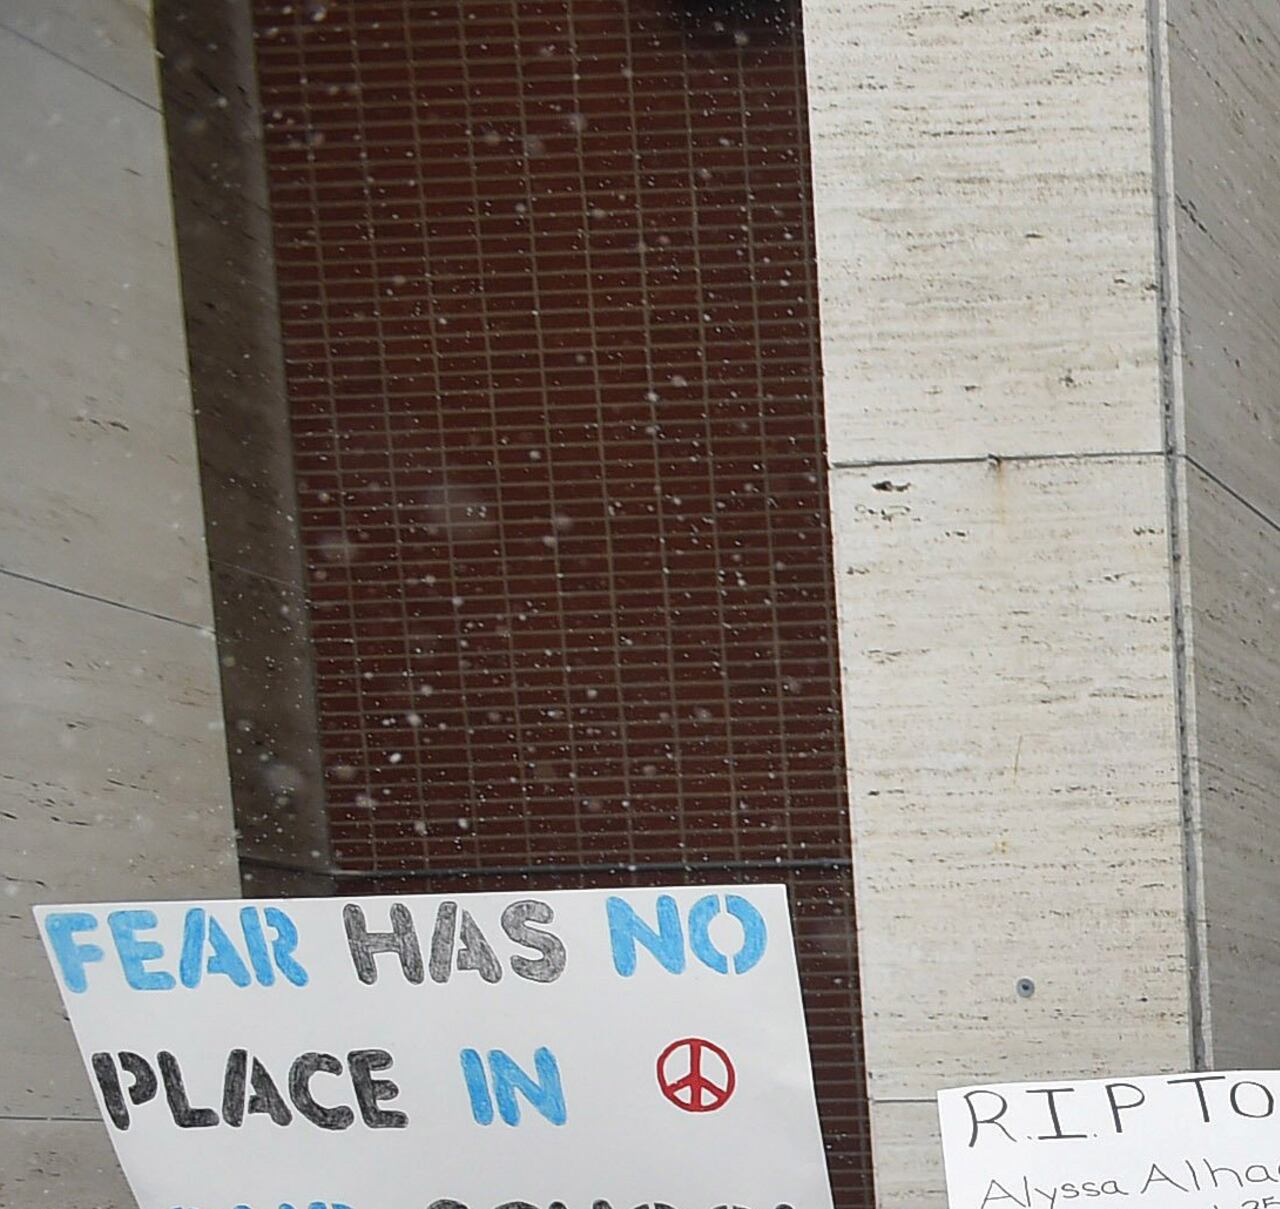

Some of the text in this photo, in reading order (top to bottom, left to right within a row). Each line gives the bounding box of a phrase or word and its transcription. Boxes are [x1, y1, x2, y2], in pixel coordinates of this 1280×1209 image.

[43, 893, 768, 994] FEAR HAS NO
[91, 1045, 568, 1131] PLACE IN
